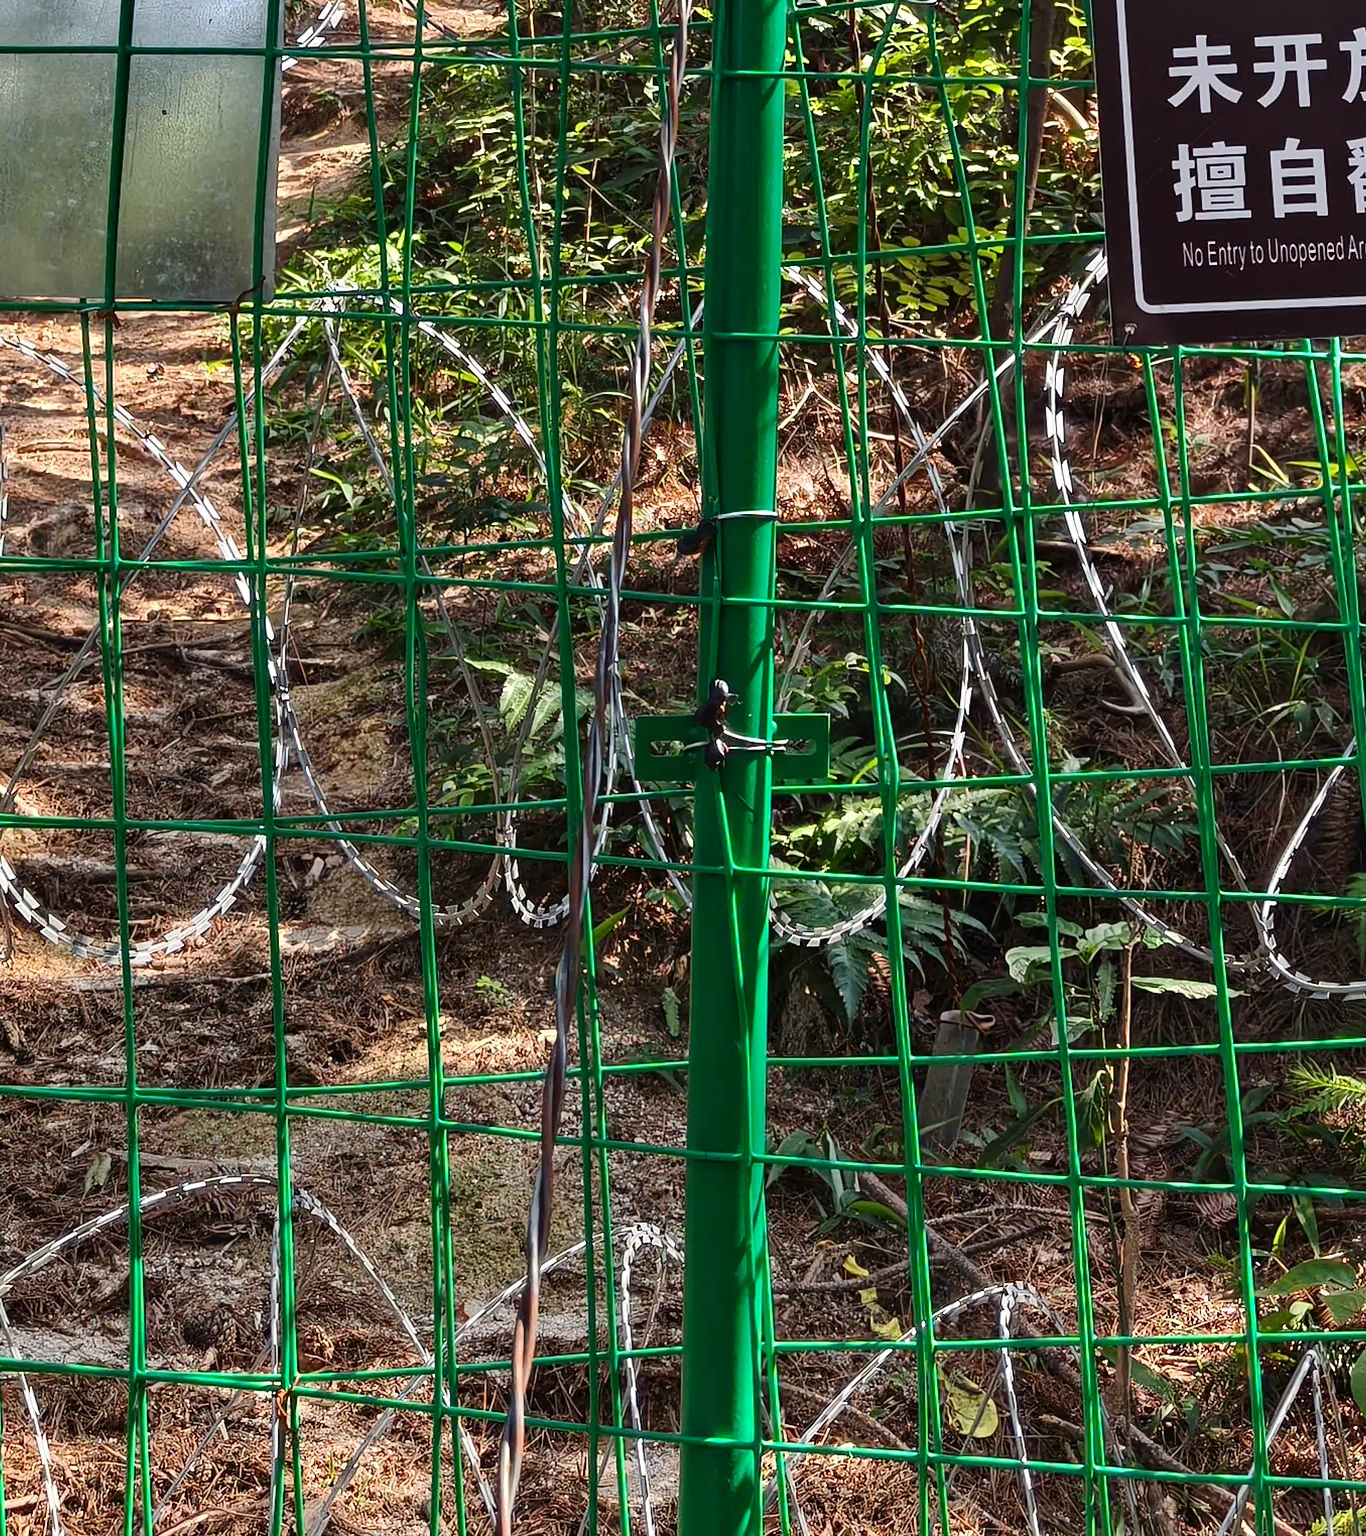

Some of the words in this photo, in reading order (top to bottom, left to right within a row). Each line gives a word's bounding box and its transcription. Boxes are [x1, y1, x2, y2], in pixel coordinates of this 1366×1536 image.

[1182, 242, 1204, 267] No
[1207, 240, 1246, 271] Entry
[1249, 240, 1264, 264] to
[1267, 236, 1345, 269] Unopened
